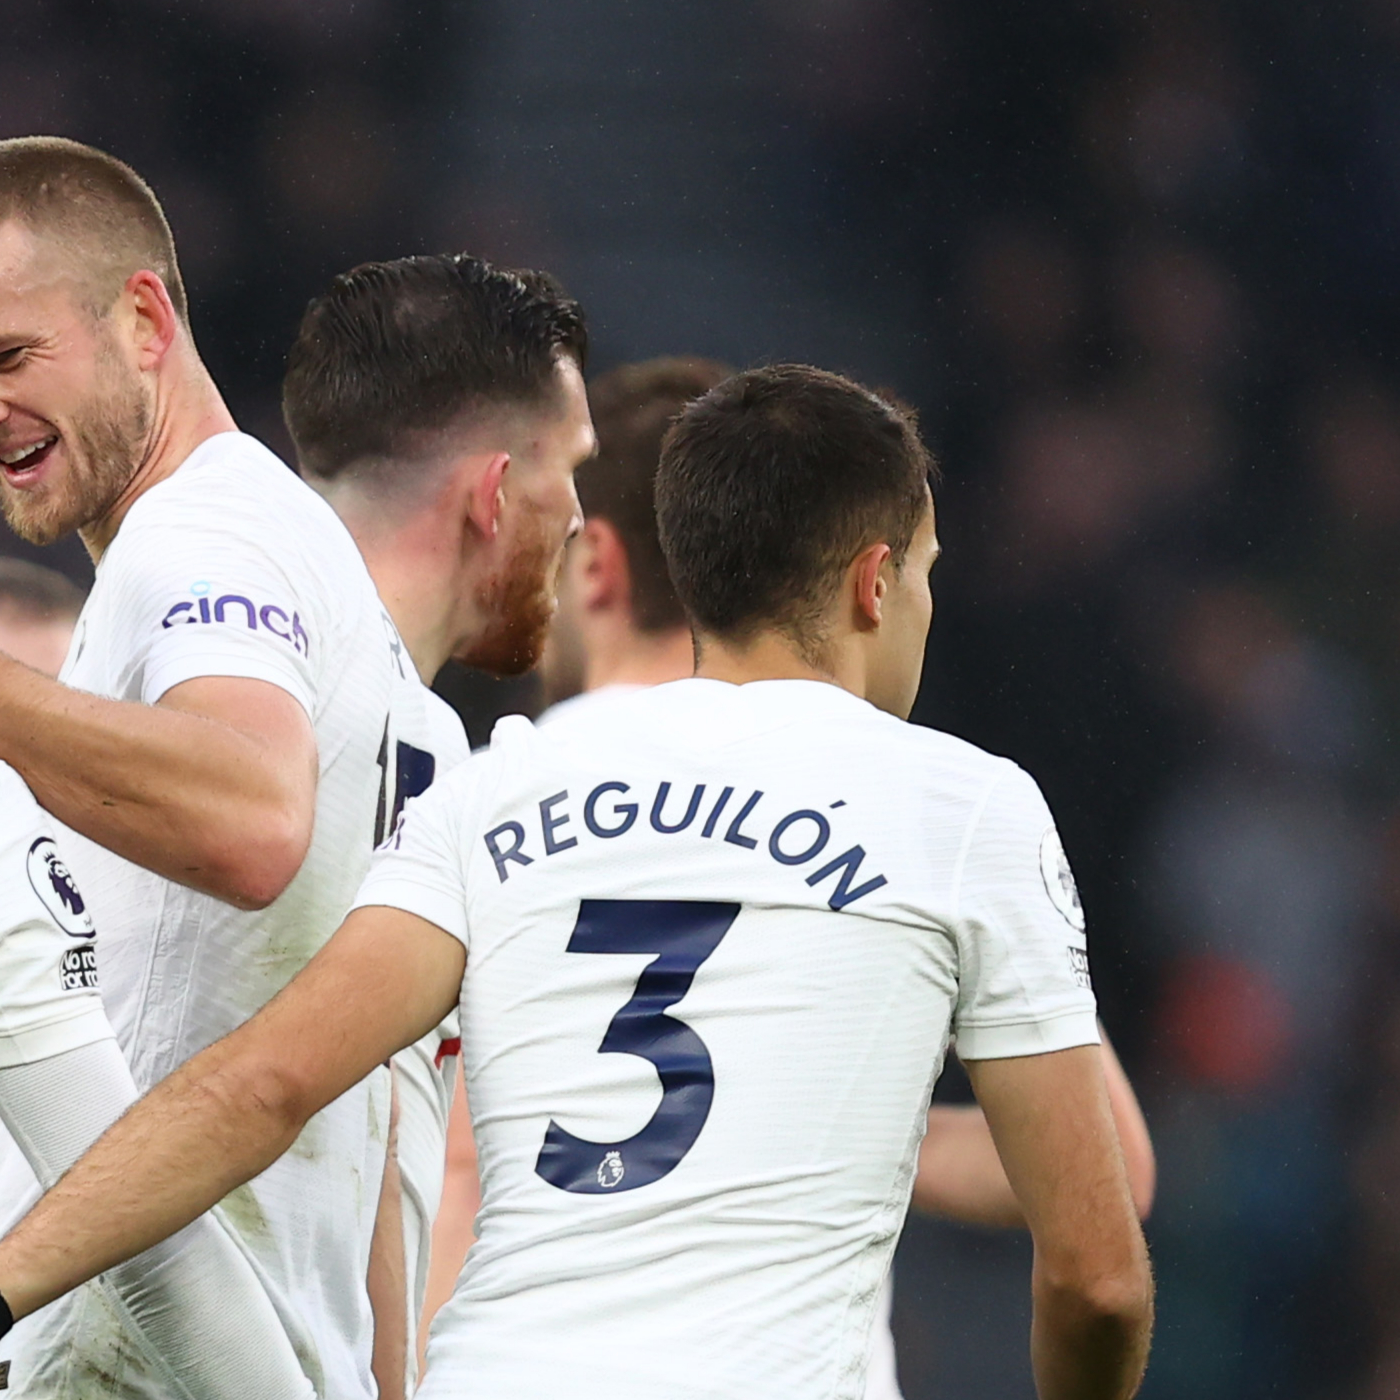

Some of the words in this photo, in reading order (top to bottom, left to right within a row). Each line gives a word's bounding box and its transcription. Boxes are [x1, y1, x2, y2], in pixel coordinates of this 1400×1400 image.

[162, 580, 309, 659] cinch
[484, 781, 888, 911] REGUILÓN
[534, 898, 742, 1195] 3
